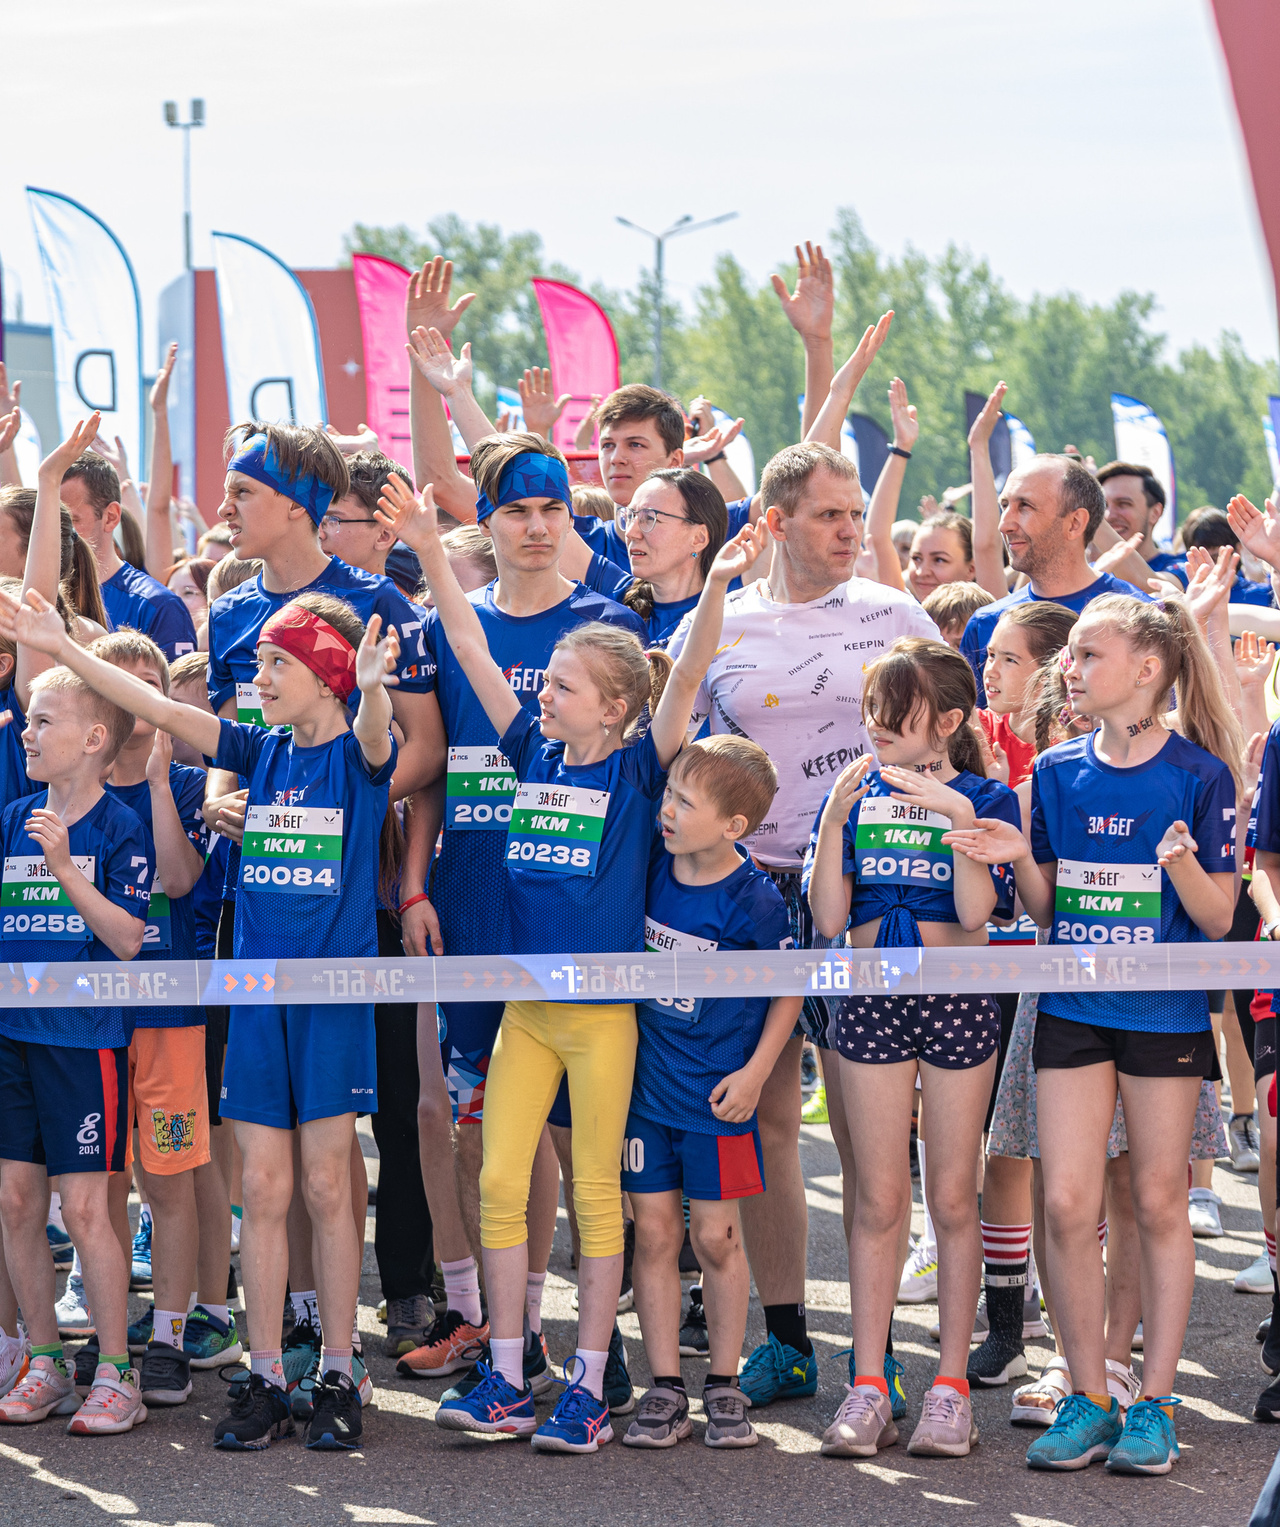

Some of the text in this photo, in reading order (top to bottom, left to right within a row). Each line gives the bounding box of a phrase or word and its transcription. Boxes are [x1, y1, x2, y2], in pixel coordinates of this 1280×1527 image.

[401, 621, 426, 657] 7
[844, 640, 885, 651] KEEPIN
[788, 652, 824, 676] DISCOVER
[811, 668, 834, 697] 1987
[801, 744, 864, 780] KEEPIN
[530, 815, 571, 832] 1KM
[263, 838, 306, 854] 1KM
[883, 829, 933, 846] 1KM
[507, 841, 591, 867] 20238
[130, 855, 149, 884] 7
[243, 864, 335, 887] 20084
[861, 856, 952, 882] 20120
[22, 887, 60, 901] 1KM
[1079, 895, 1124, 912] 1KM
[3, 913, 85, 933] 20258
[1057, 921, 1155, 945] 20068
[162, 1119, 191, 1140] SKATE
[79, 1145, 100, 1155] 2014
